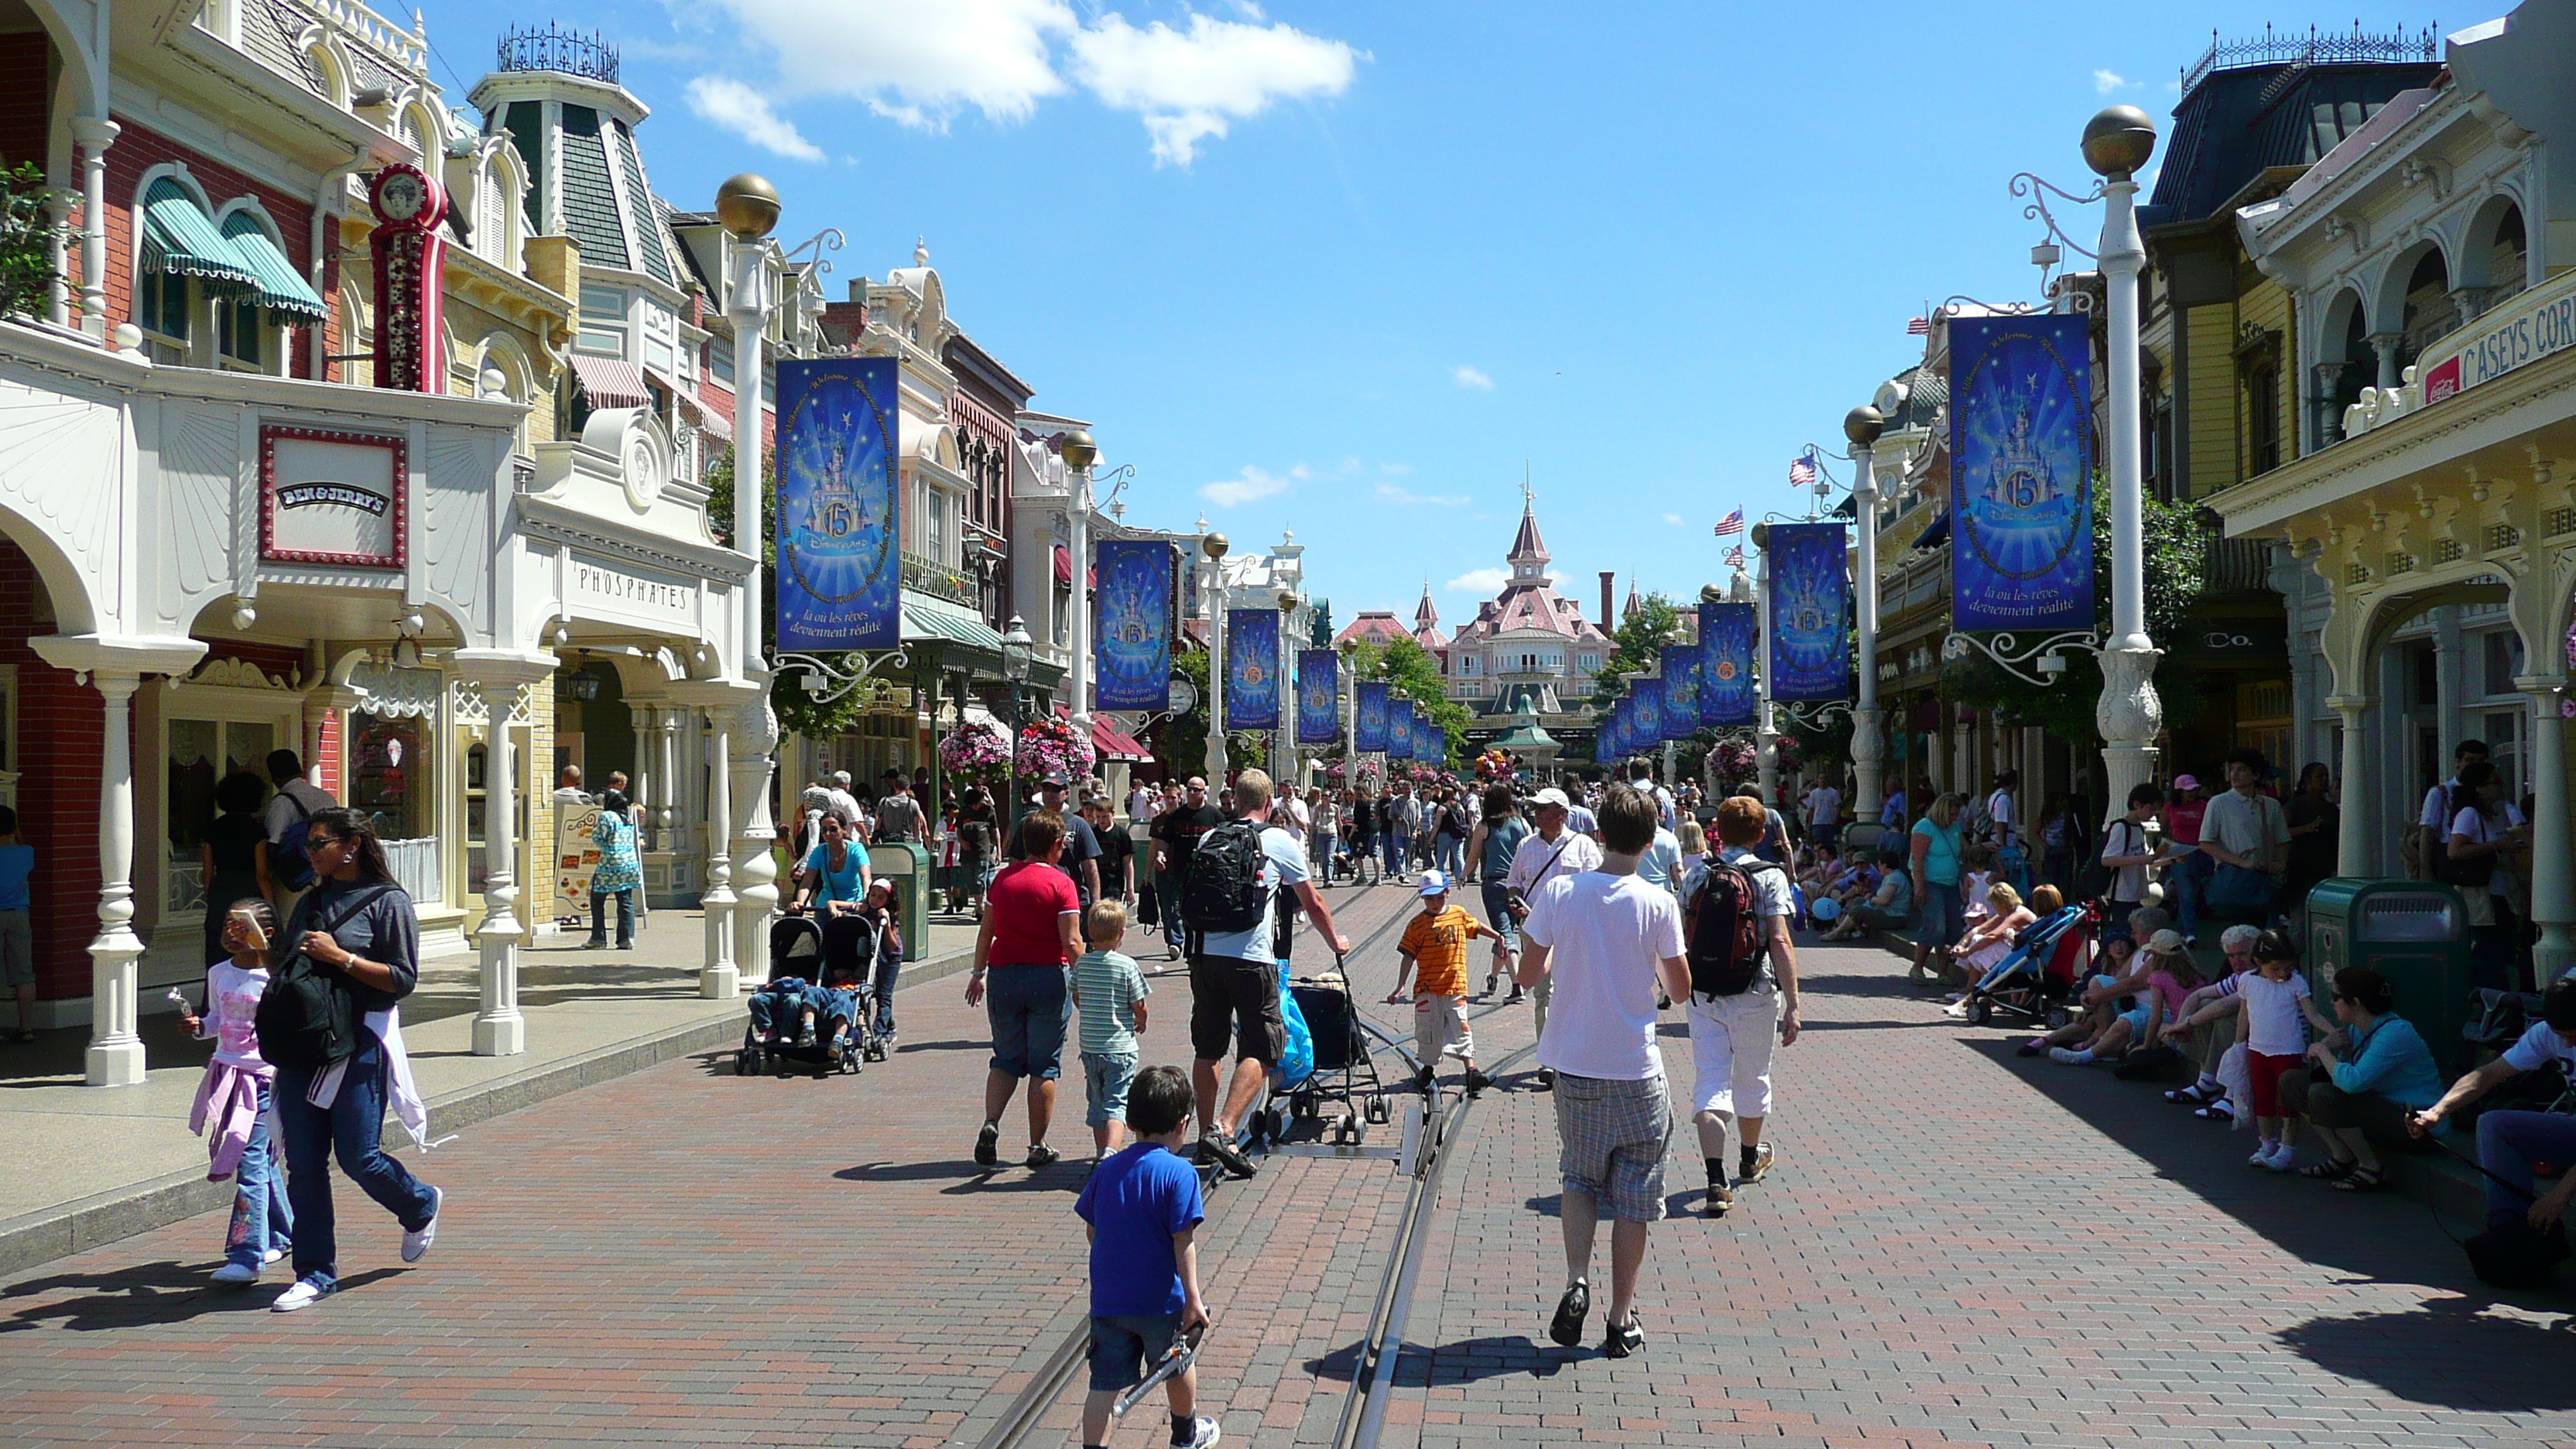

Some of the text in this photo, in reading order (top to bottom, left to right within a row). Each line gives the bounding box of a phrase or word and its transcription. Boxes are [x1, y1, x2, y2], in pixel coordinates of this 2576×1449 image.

[810, 374, 848, 389] Welcome
[2008, 471, 2037, 508] 15
[824, 502, 851, 538] 15
[581, 568, 686, 609] PHOSPHATES
[1985, 586, 2059, 601] là où les rêves
[1969, 597, 2074, 616] deviennent réalité
[803, 609, 868, 623] là où les rêves
[790, 620, 882, 638] deviennent réalité
[2203, 632, 2253, 648] Co.
